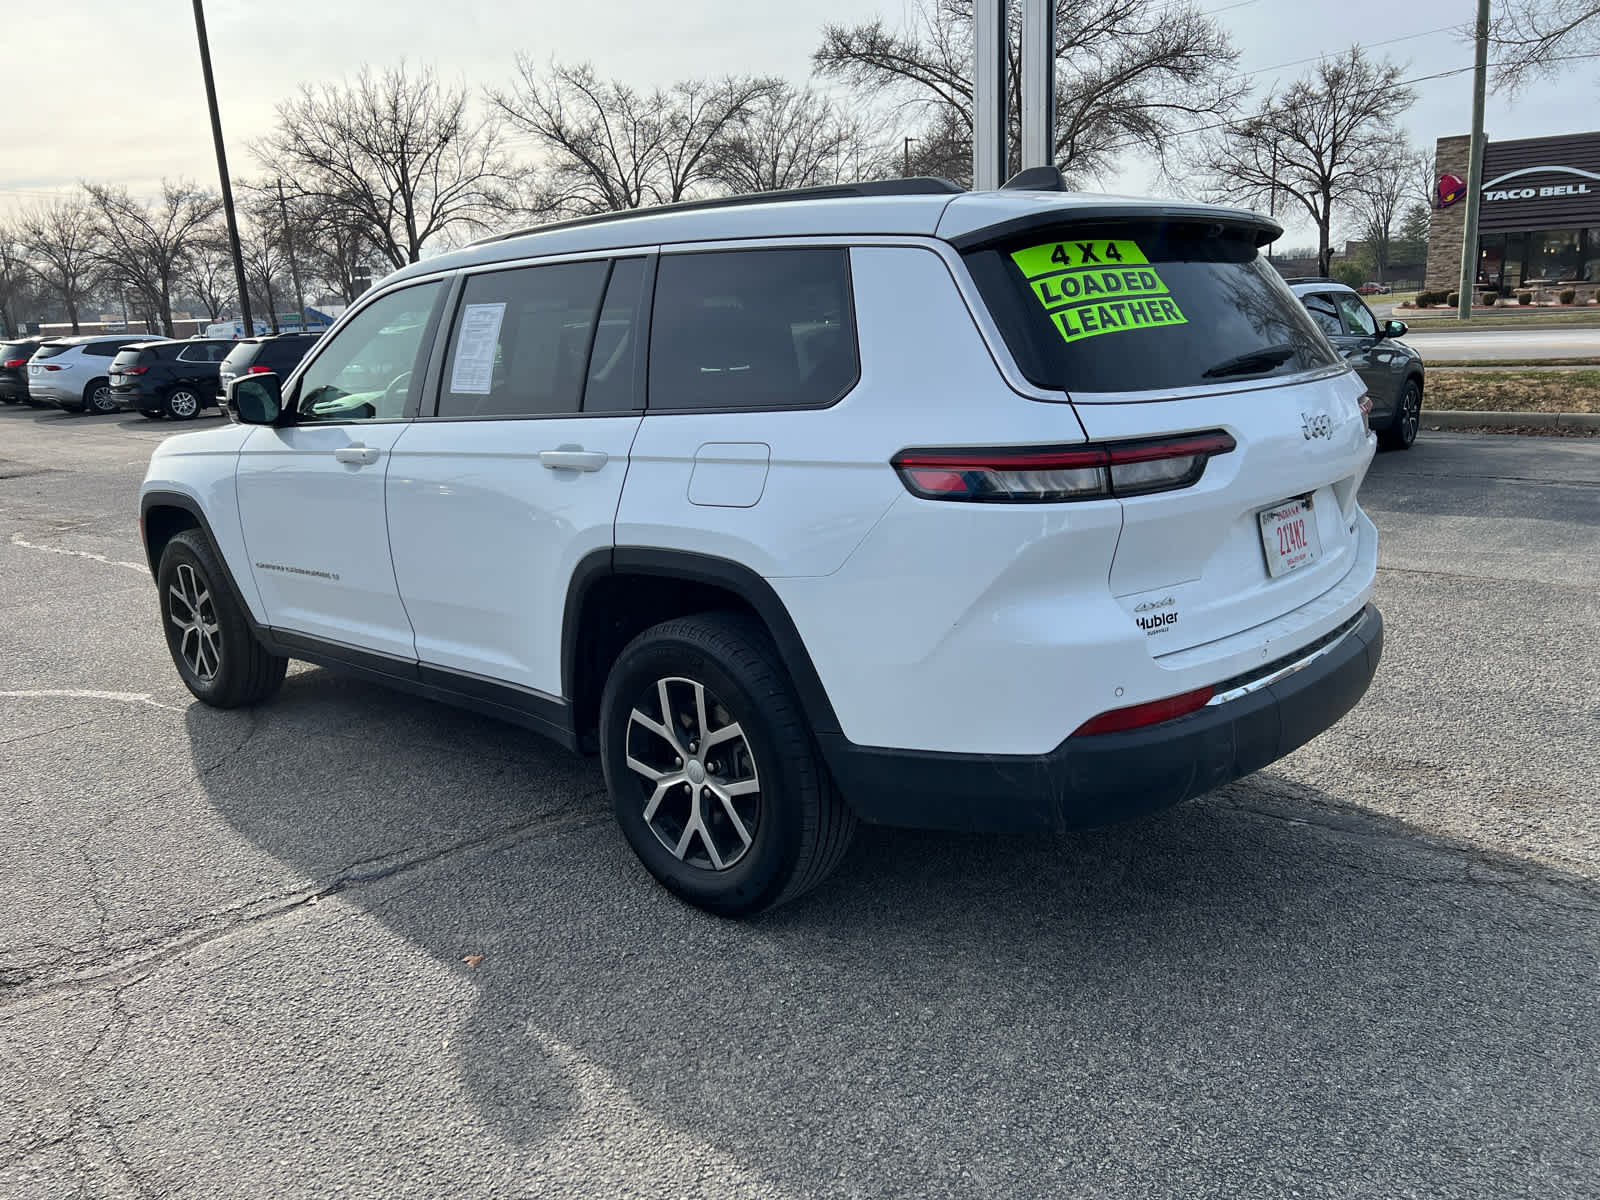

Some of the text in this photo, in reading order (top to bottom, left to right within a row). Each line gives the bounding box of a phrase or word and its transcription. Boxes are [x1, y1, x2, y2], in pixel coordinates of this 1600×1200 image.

[1484, 184, 1592, 200] TACO BELL
[1040, 271, 1158, 304] LOADED
[1060, 300, 1180, 337] LEATHER
[1301, 412, 1333, 441] Jeep
[1136, 612, 1178, 630] Hubler
